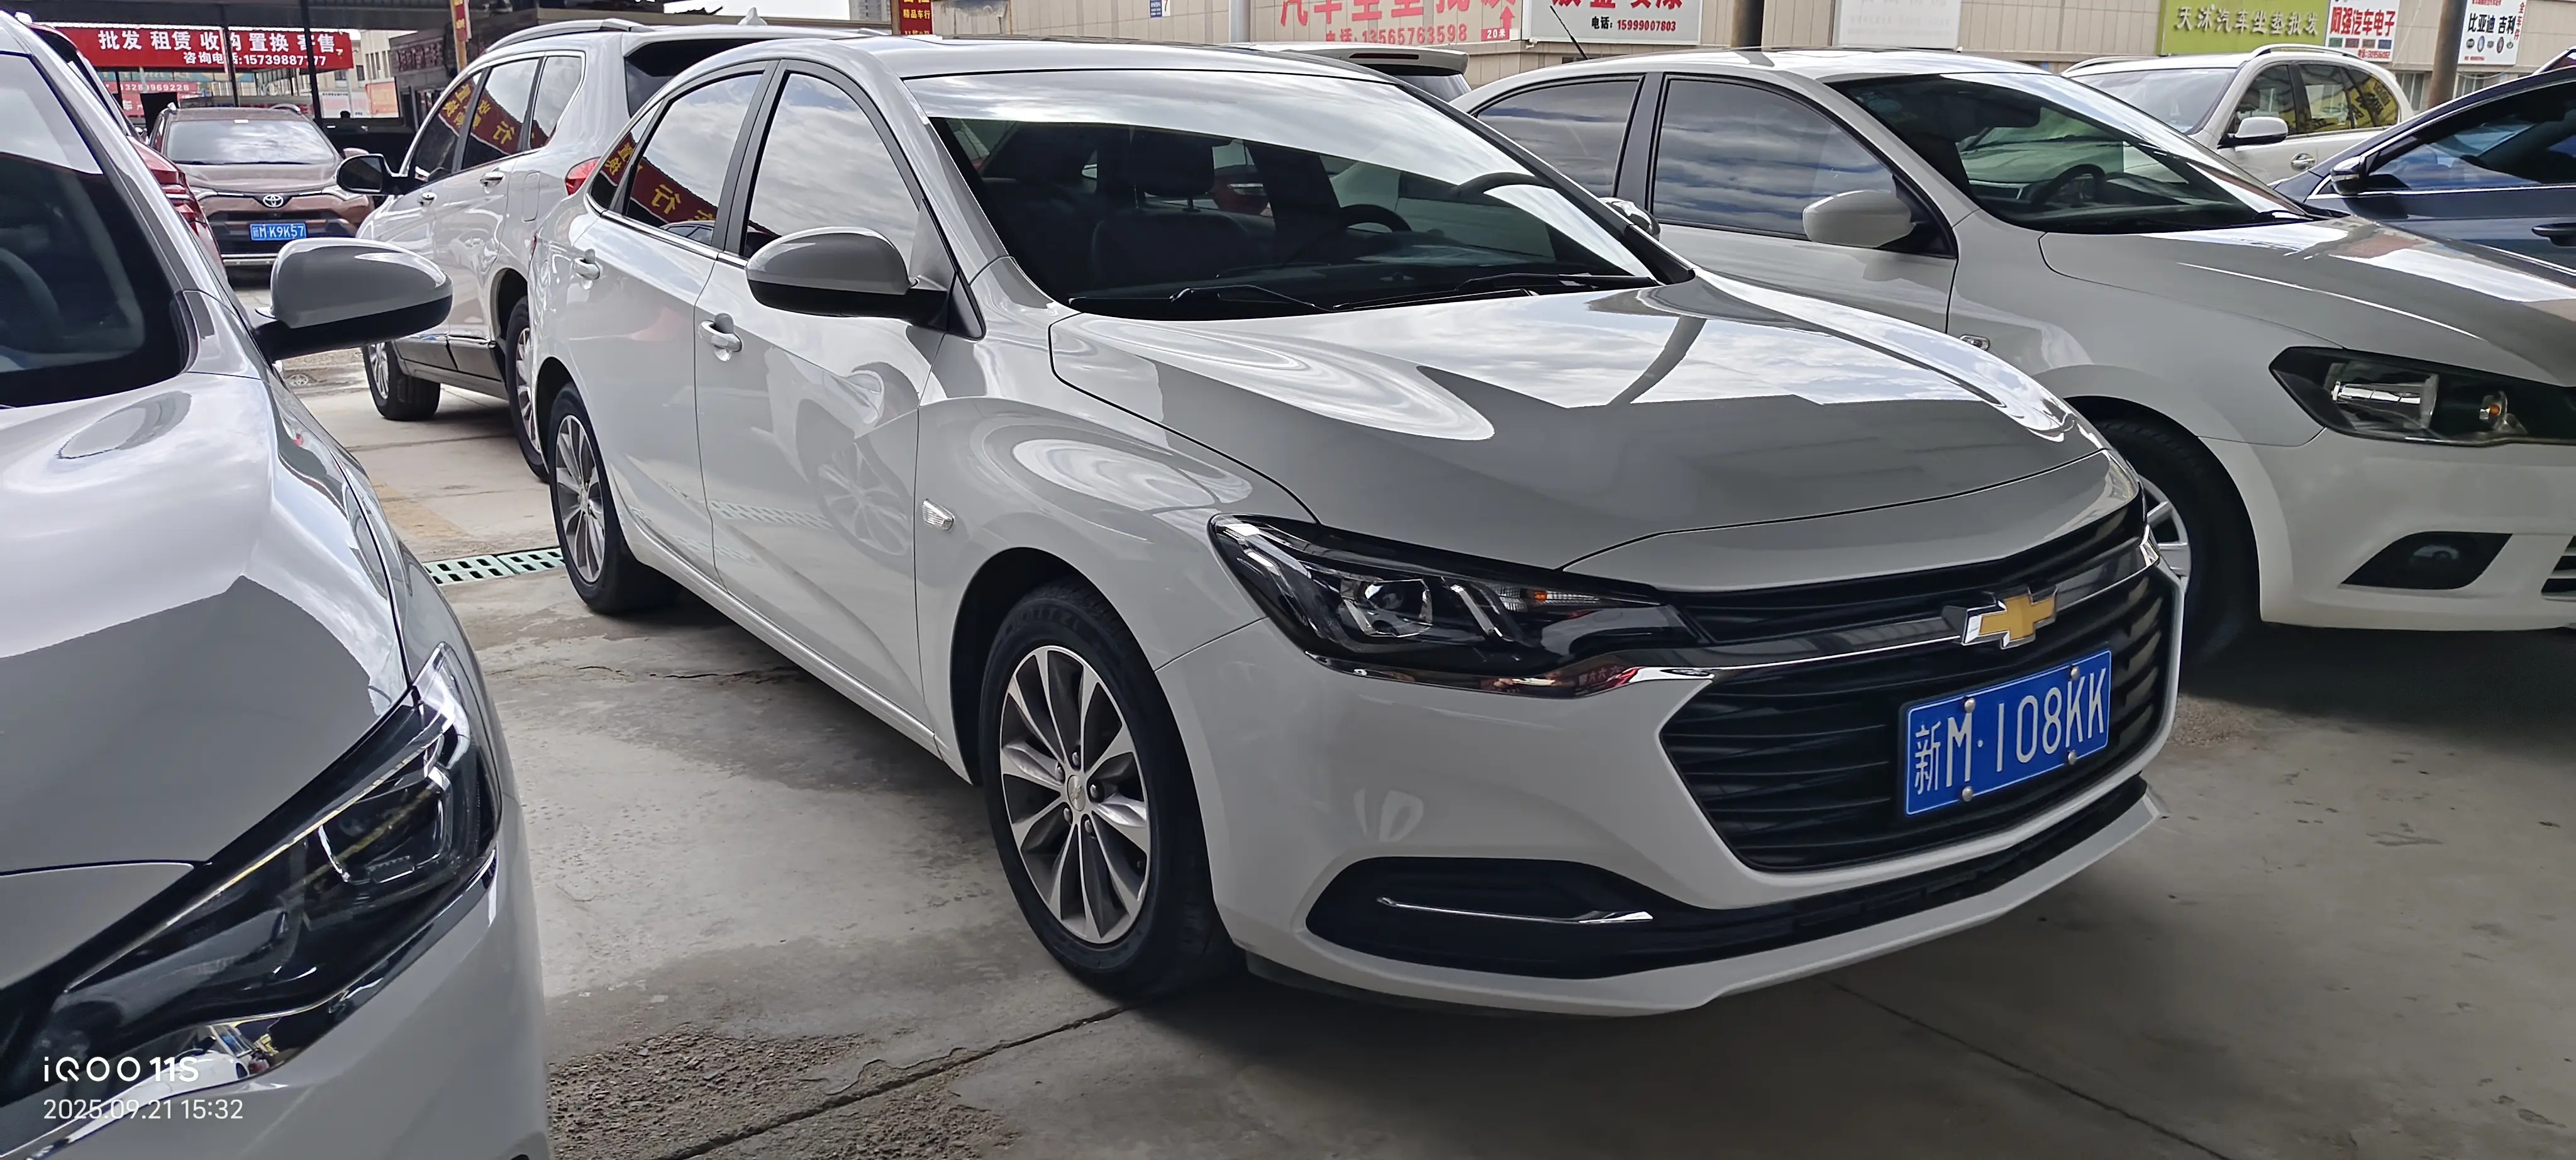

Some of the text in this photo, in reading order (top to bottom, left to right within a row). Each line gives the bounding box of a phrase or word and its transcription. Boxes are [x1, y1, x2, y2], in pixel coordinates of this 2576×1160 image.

[902, 8, 931, 20] 精品车行
[1617, 20, 1677, 31] 15999007803
[2467, 13, 2516, 35] 比亚迪 吉利
[1487, 28, 1506, 39] 20米
[97, 30, 142, 50] 批发
[150, 31, 191, 51] 租赁
[249, 33, 289, 52] 置换
